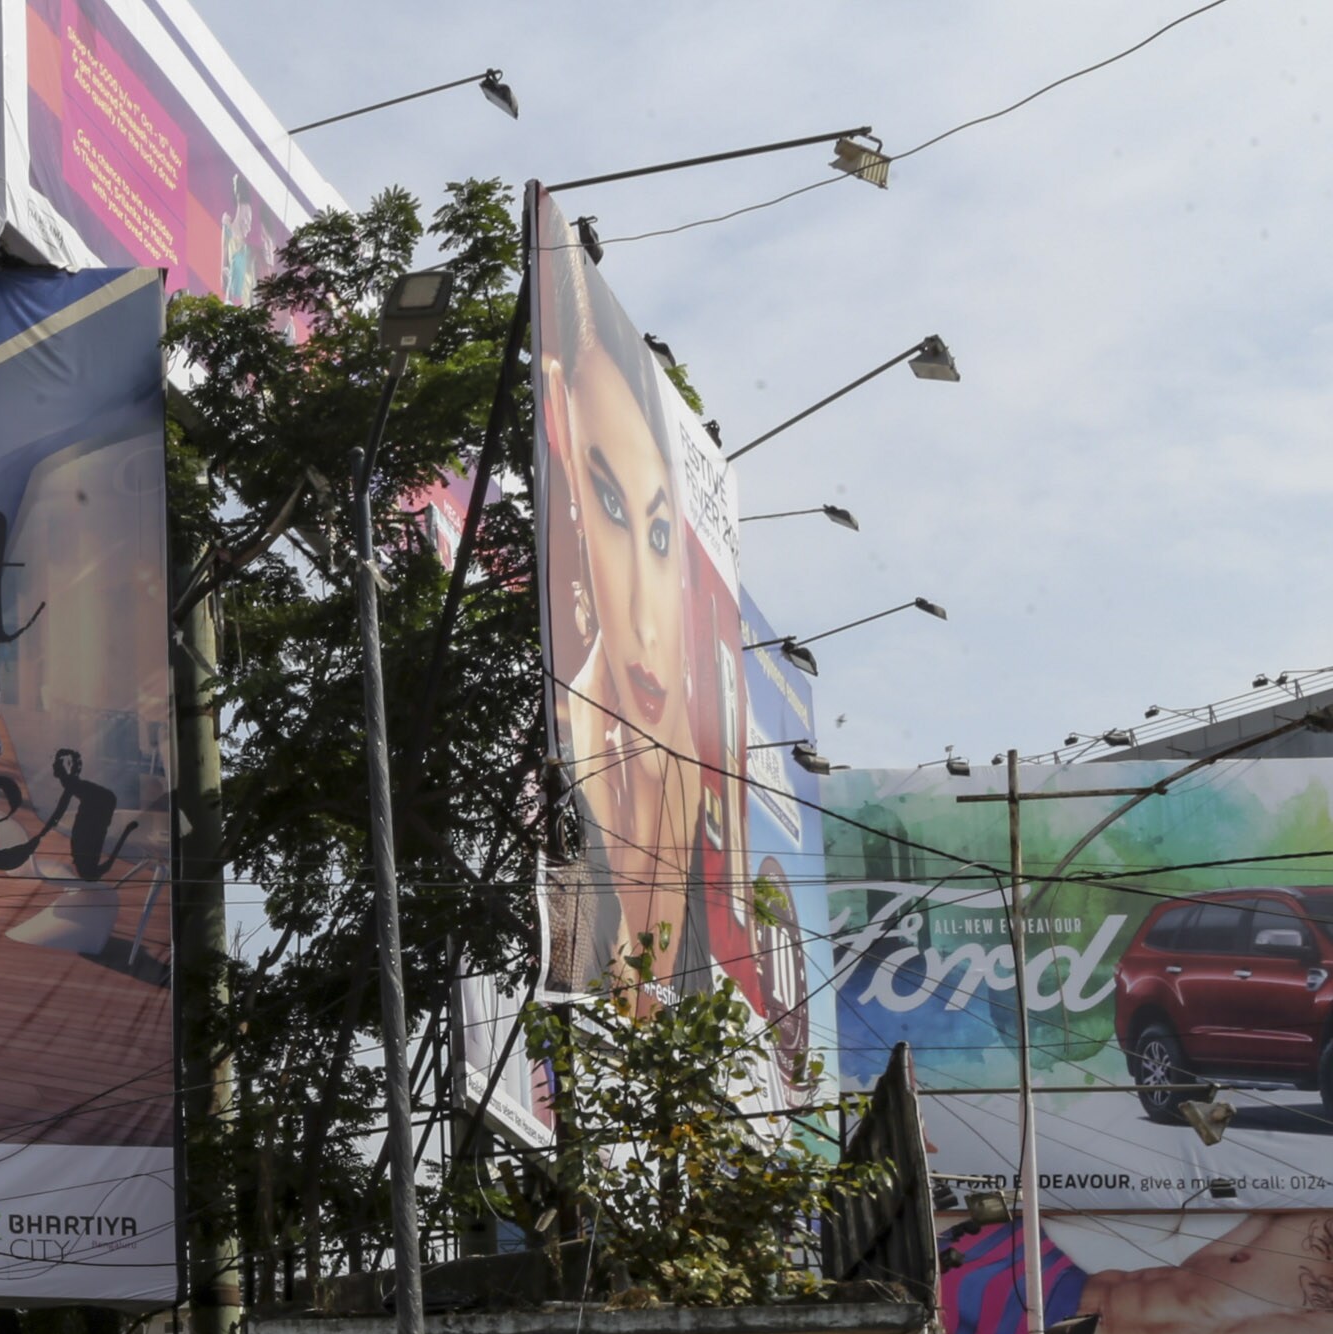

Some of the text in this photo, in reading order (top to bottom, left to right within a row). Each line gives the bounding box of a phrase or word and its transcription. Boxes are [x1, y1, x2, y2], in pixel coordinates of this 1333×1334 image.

[934, 918, 994, 935] ALL-NEW
[827, 881, 1129, 1013] Ford
[1013, 1174, 1135, 1191] EDEAVOUR,
[1141, 1177, 1168, 1192] give
[1177, 1180, 1186, 1190] a
[1252, 1176, 1285, 1190] call:
[9, 1214, 138, 1237] BHARTIYA
[10, 1238, 71, 1261] CITY
